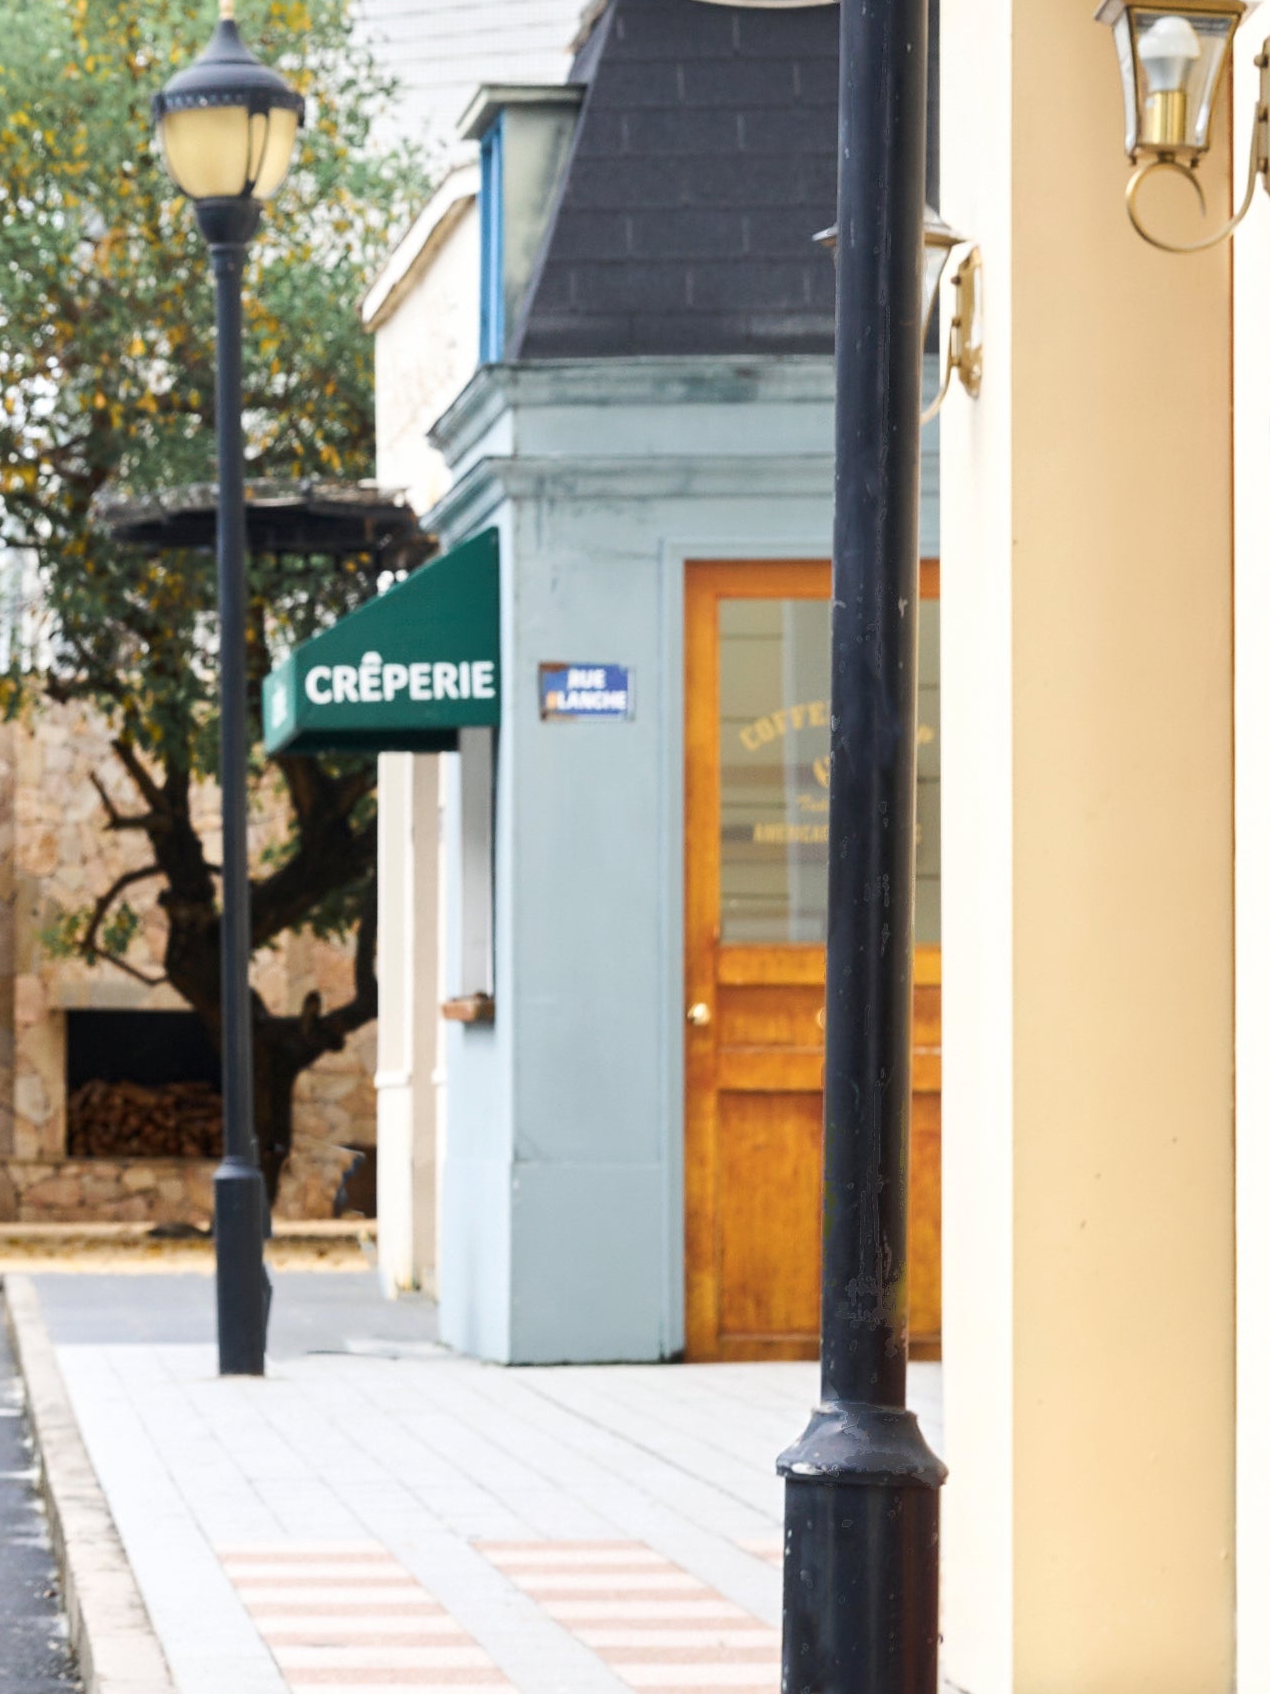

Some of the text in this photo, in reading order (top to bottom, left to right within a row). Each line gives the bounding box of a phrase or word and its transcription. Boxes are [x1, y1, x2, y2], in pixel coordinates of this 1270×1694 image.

[305, 651, 496, 704] CRÊPERIE
[567, 668, 606, 690] RUE
[739, 701, 829, 752] COFFE
